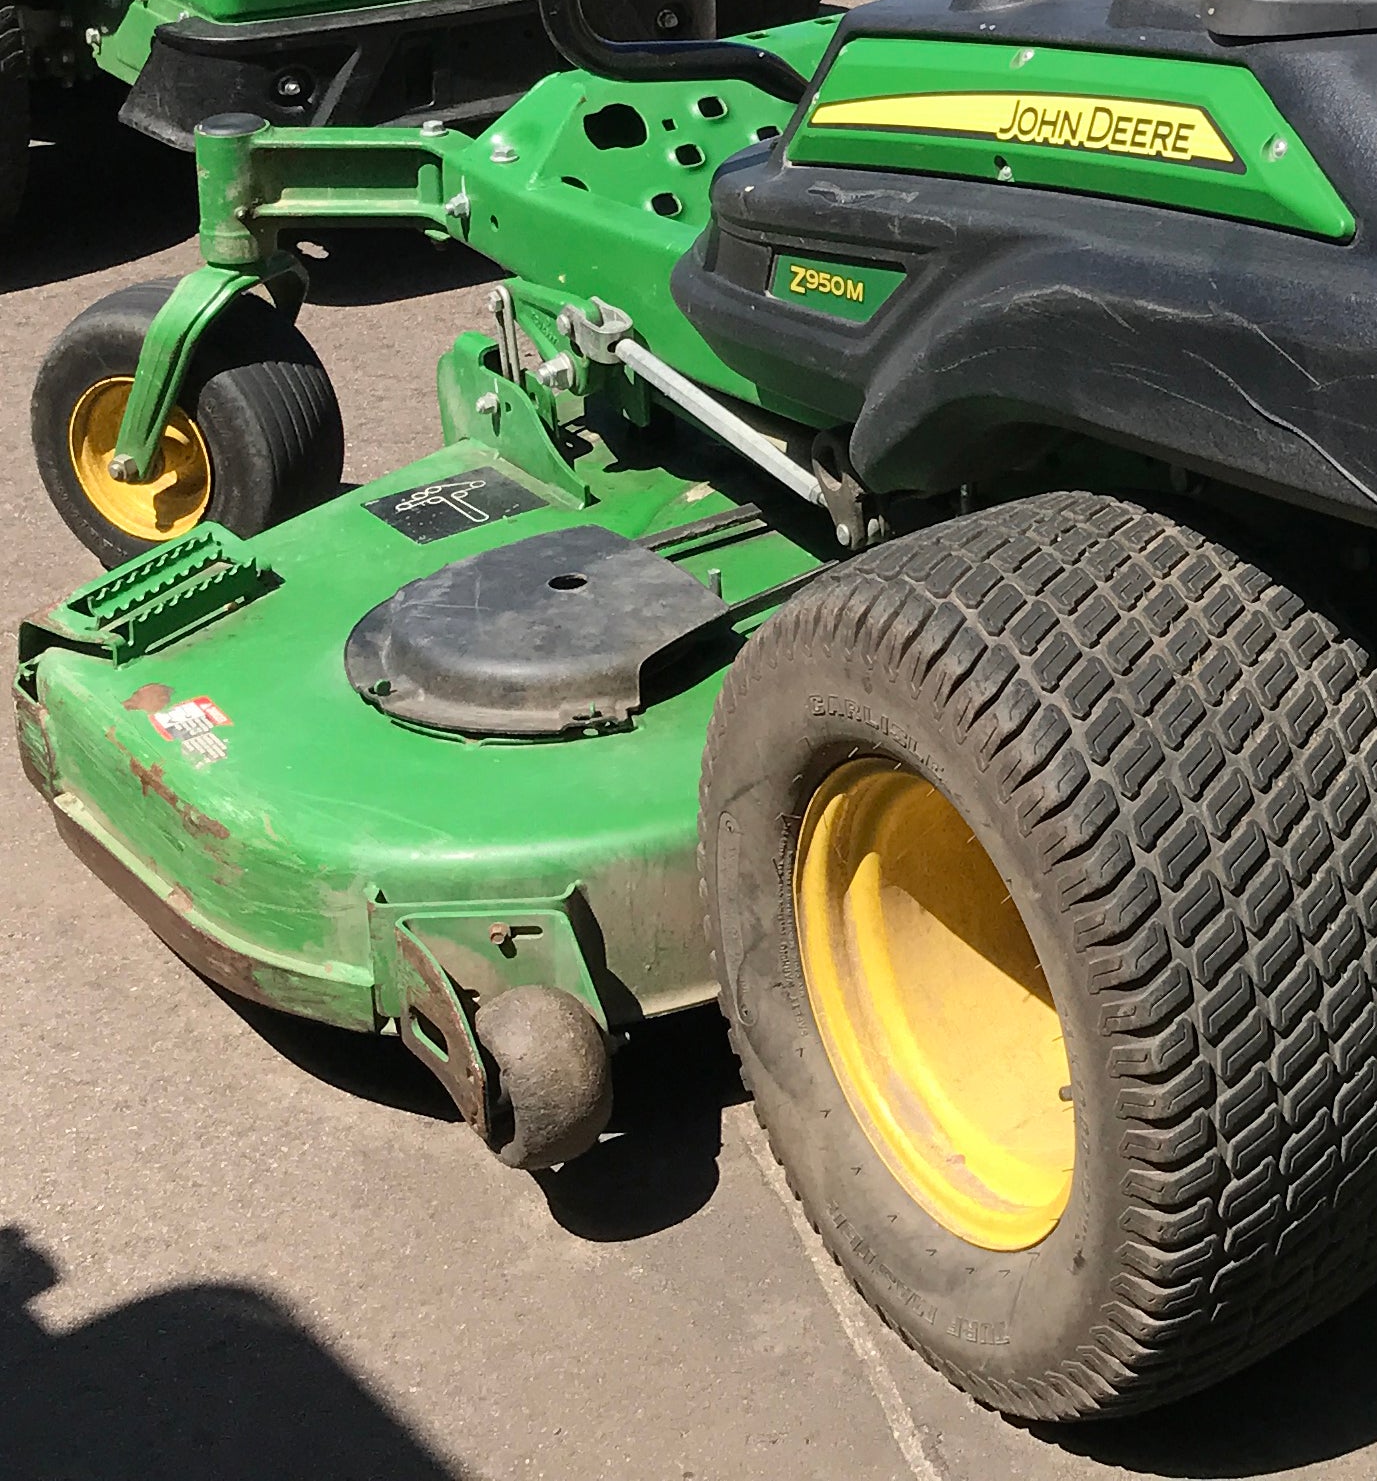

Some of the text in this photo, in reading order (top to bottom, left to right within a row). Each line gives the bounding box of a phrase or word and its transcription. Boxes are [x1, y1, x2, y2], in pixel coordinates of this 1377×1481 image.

[998, 99, 1196, 154] JOHN DEERE
[789, 264, 865, 303] Z950M
[946, 1316, 1011, 1346] TURF
